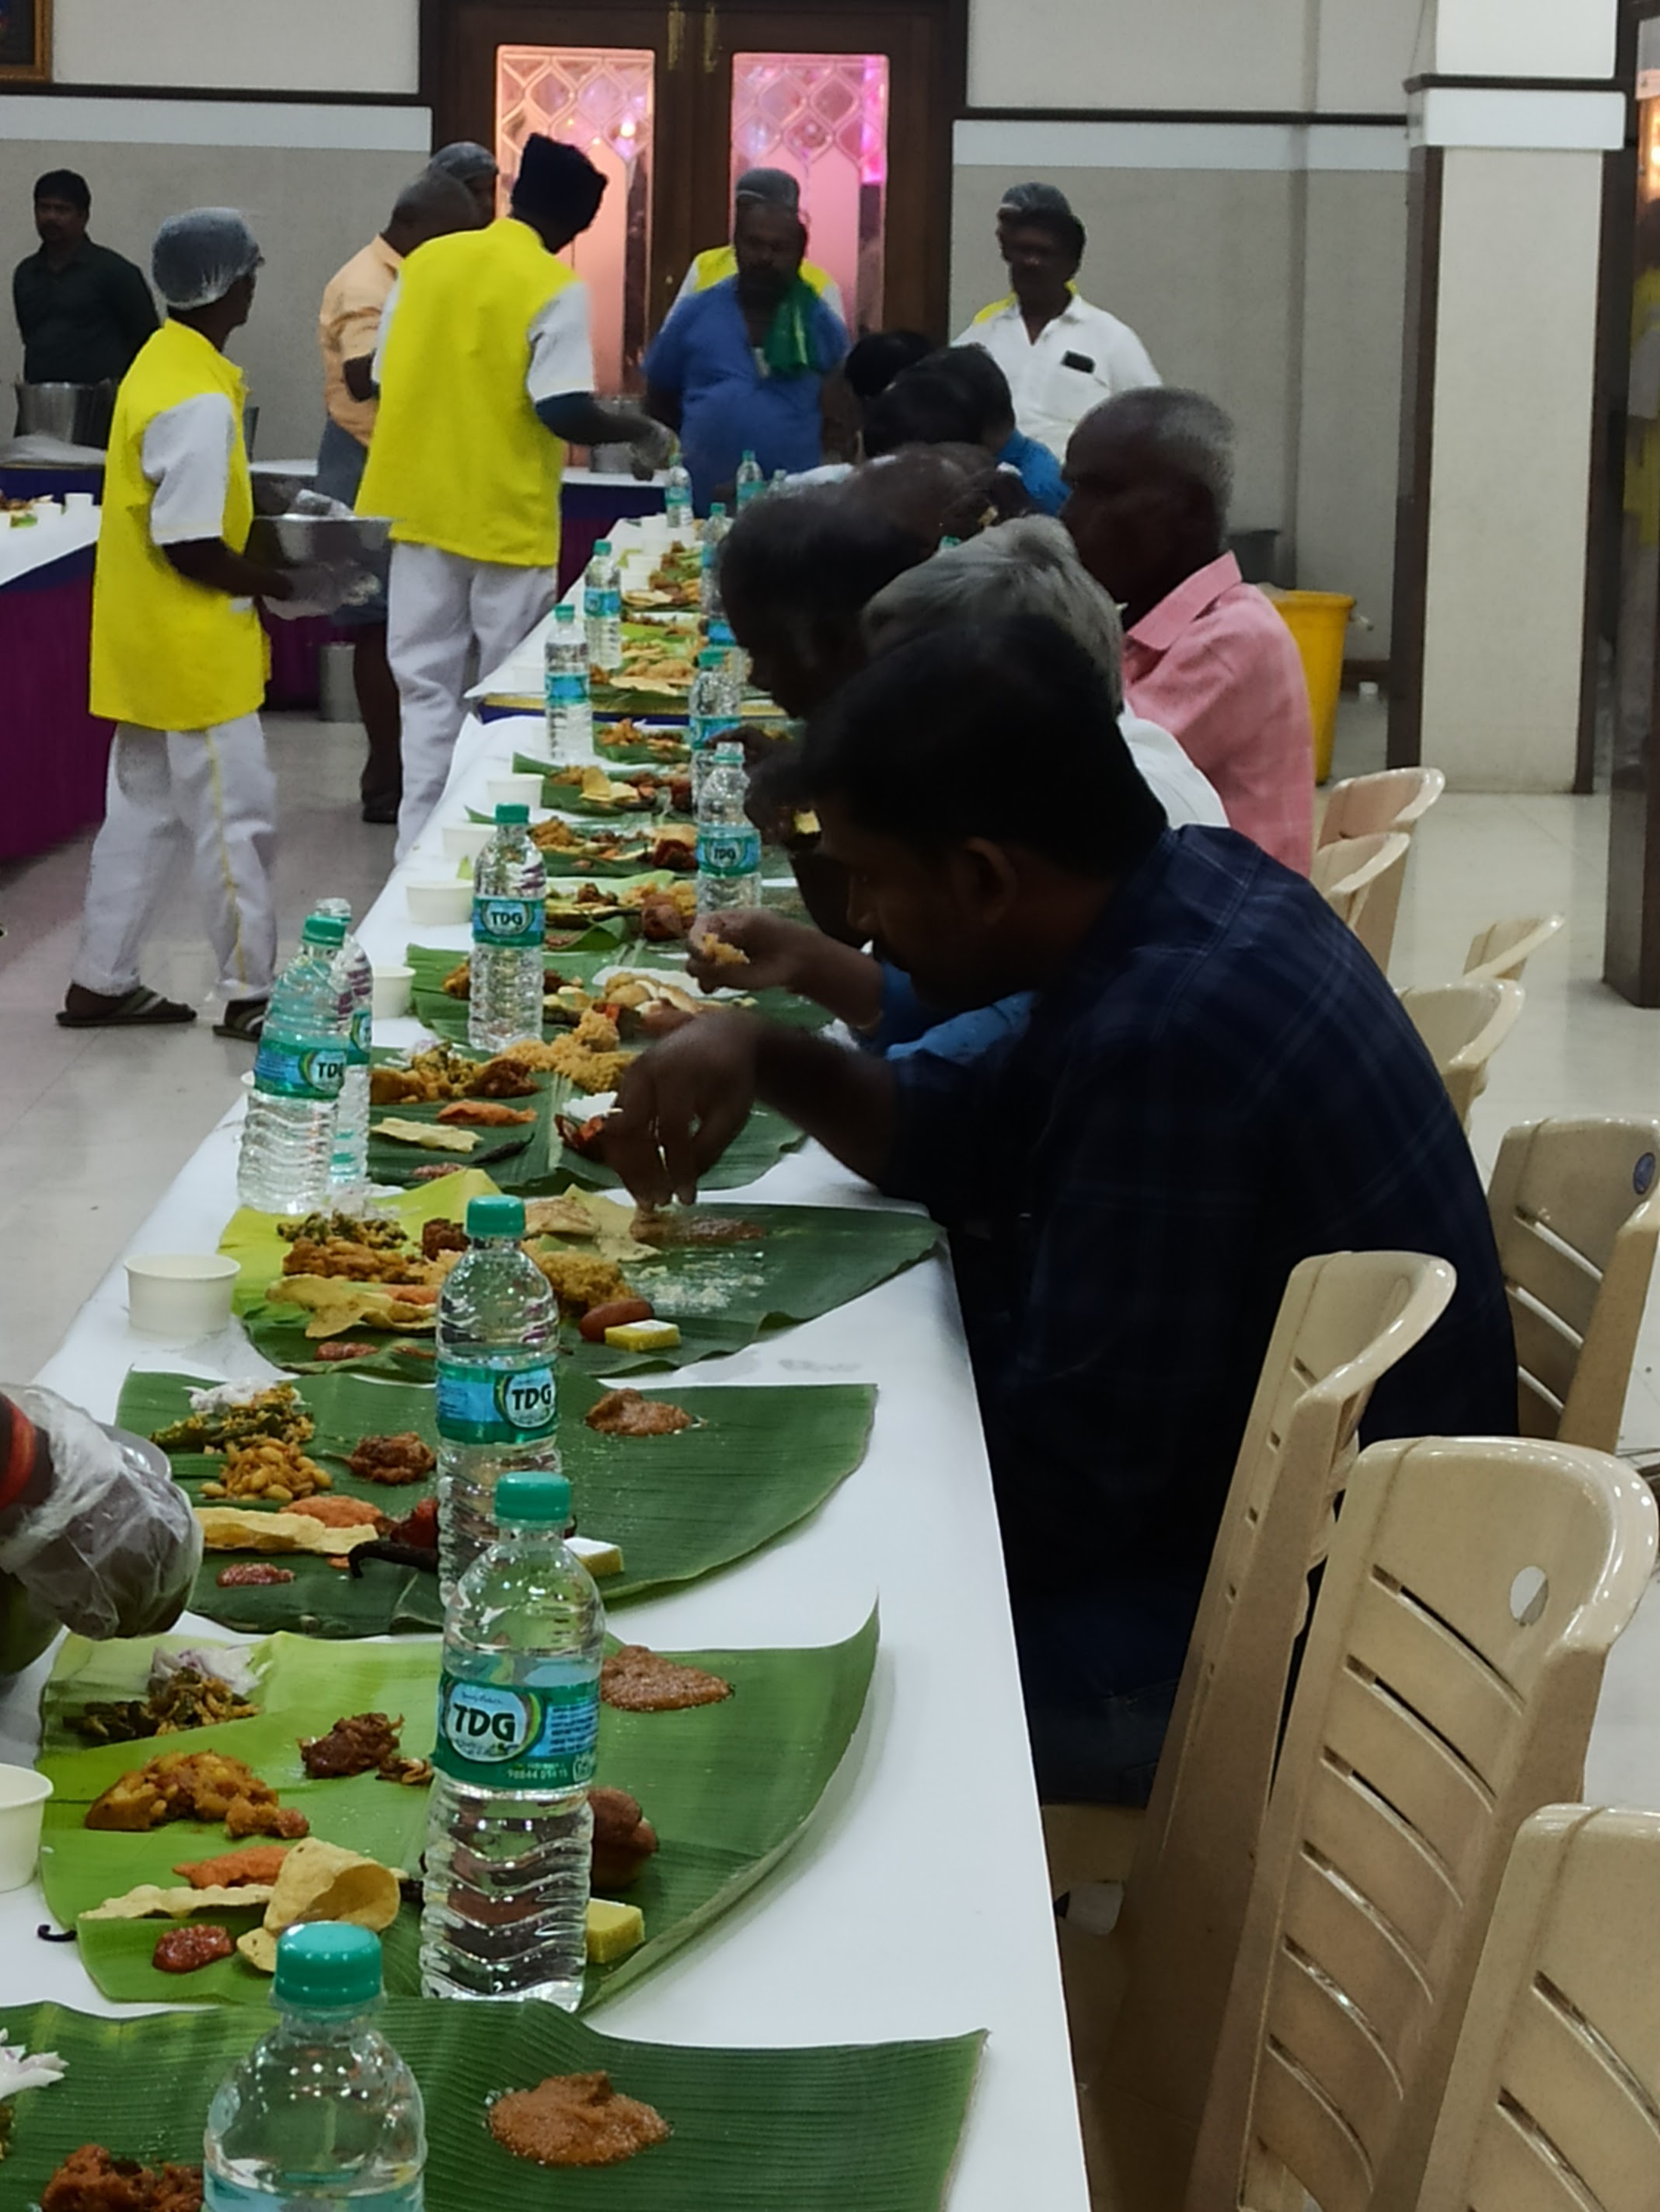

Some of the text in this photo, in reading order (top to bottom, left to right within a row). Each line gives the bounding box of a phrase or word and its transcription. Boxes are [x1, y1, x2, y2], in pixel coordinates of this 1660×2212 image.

[490, 912, 522, 925] TDG
[511, 1383, 552, 1411] TDG
[453, 1702, 515, 1742] TDG
